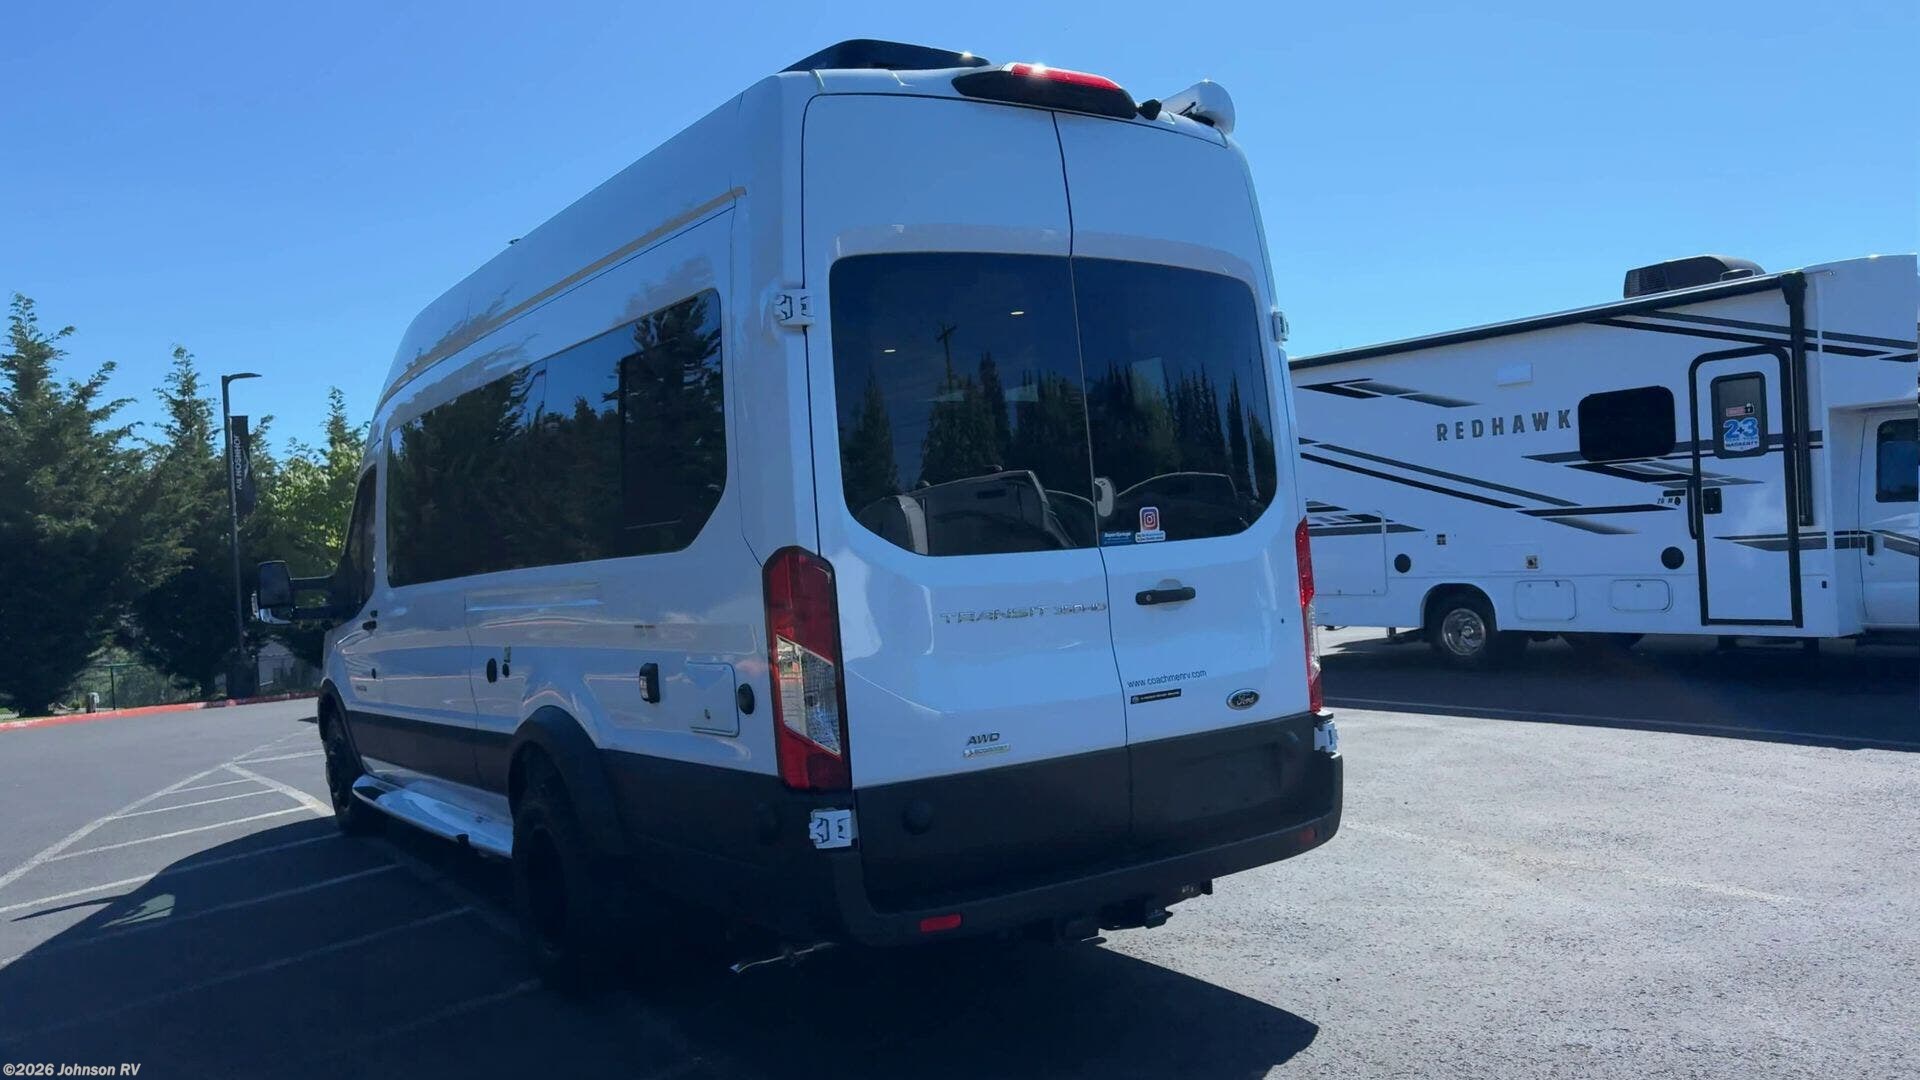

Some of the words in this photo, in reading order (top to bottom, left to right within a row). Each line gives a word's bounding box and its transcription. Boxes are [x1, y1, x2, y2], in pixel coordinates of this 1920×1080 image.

[1436, 409, 1571, 441] REDHAWK
[233, 434, 242, 476] JOHNSON
[941, 606, 1048, 623] TRANSIT
[967, 732, 1000, 746] AWD
